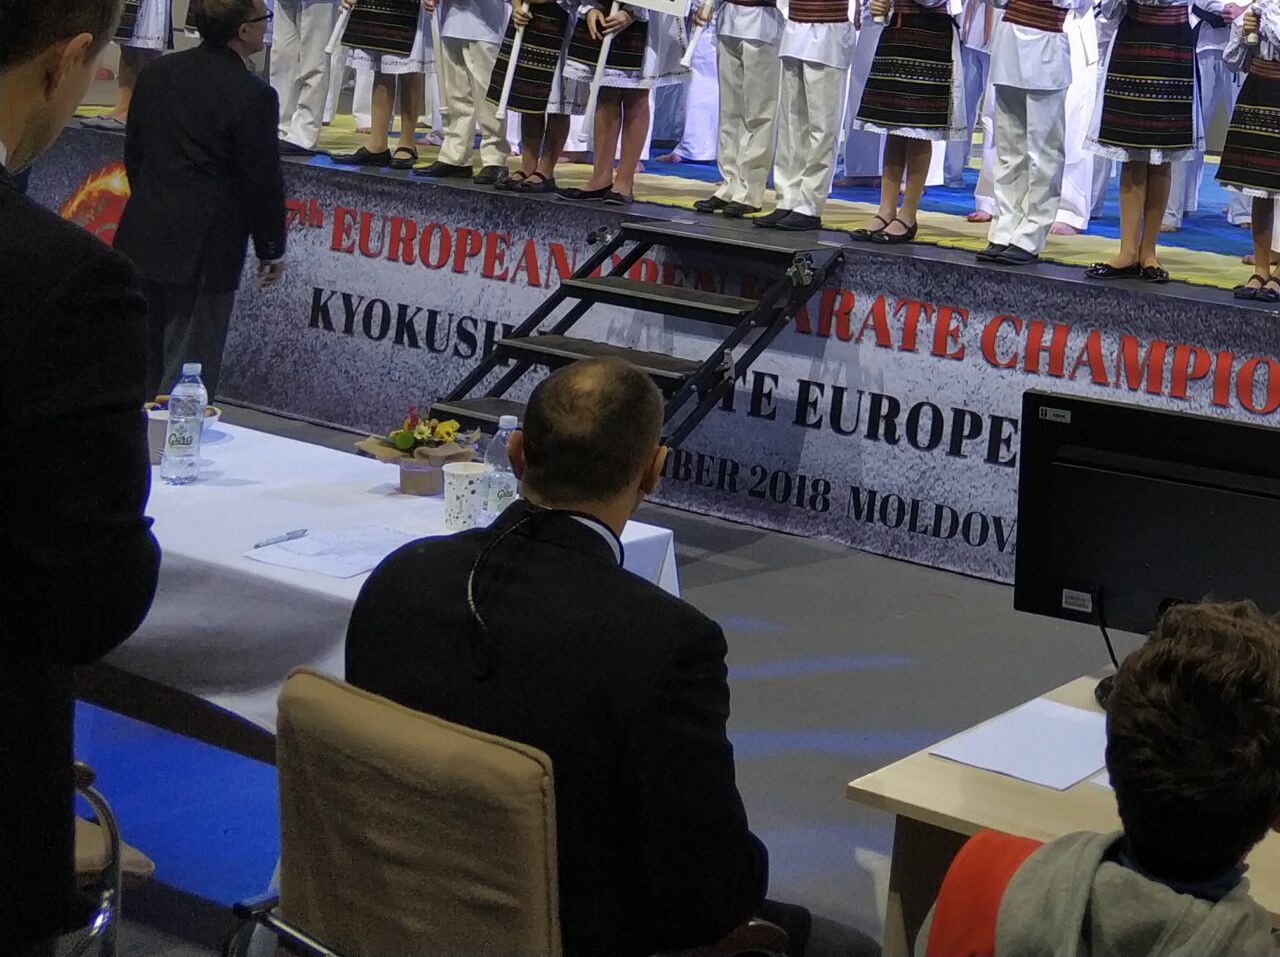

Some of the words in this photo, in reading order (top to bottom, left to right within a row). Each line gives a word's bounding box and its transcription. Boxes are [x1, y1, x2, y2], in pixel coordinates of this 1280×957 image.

[330, 205, 577, 289] EUROPEAN
[793, 378, 1020, 468] EUROPE
[748, 463, 832, 513] 2018
[847, 484, 1018, 555] MOLDOV
